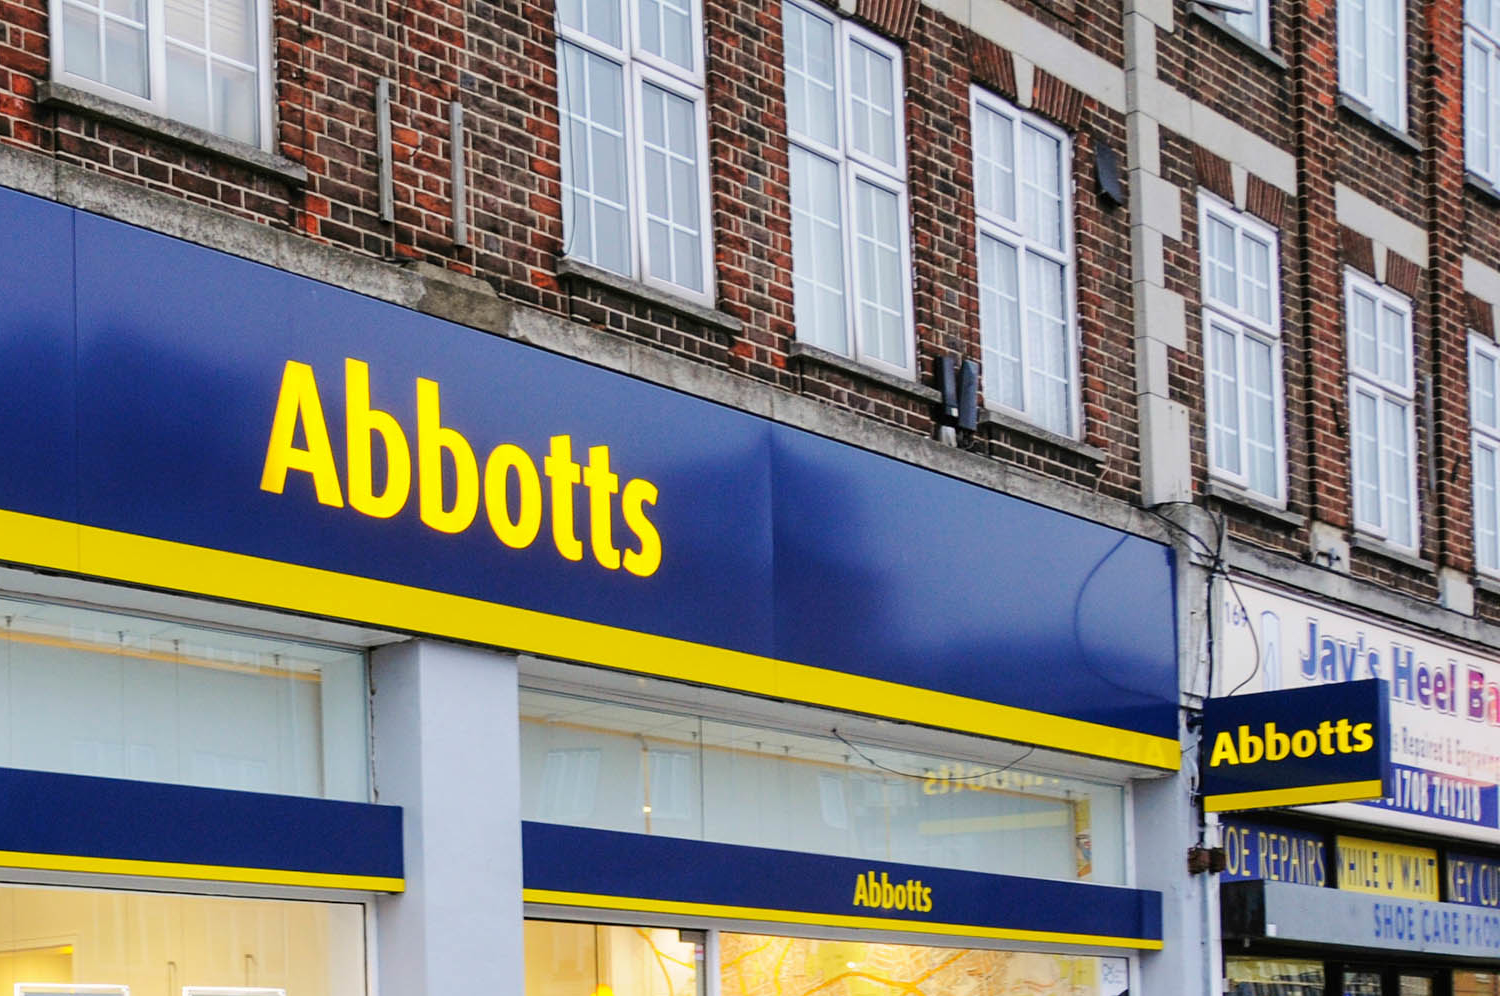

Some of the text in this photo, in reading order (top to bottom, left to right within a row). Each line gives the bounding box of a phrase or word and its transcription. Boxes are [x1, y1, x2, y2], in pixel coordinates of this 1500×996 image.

[260, 357, 662, 577] Abbotts
[1390, 642, 1457, 717] Heel
[1210, 719, 1373, 767] Abbotts
[1386, 768, 1428, 812] 1708
[1222, 826, 1326, 887] OE REPAIRS
[853, 871, 933, 912] Abbotts
[1448, 860, 1473, 903] KEY
[1374, 904, 1414, 940] SHOE
[1423, 909, 1459, 945] CARE
